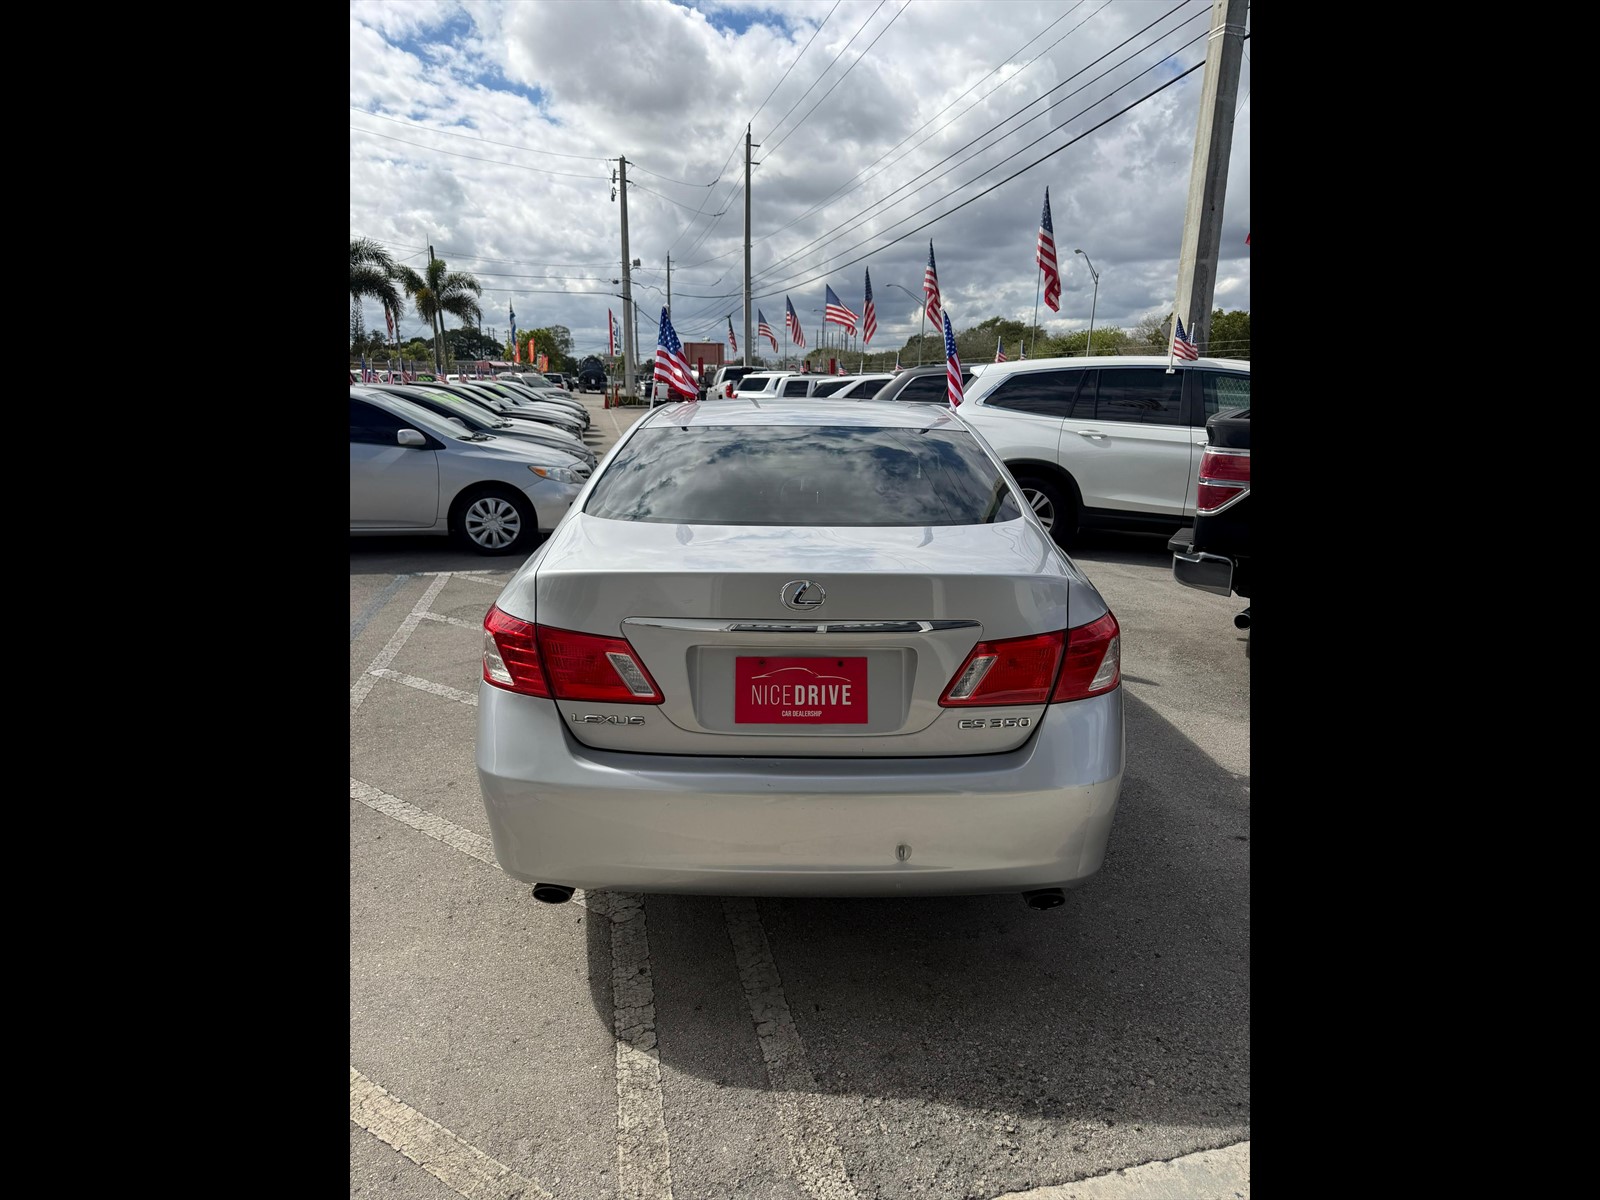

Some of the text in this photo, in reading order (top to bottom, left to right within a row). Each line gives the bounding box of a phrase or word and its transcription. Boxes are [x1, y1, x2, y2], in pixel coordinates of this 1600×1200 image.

[571, 713, 645, 726] LEXUS
[958, 717, 1031, 730] ES 350
